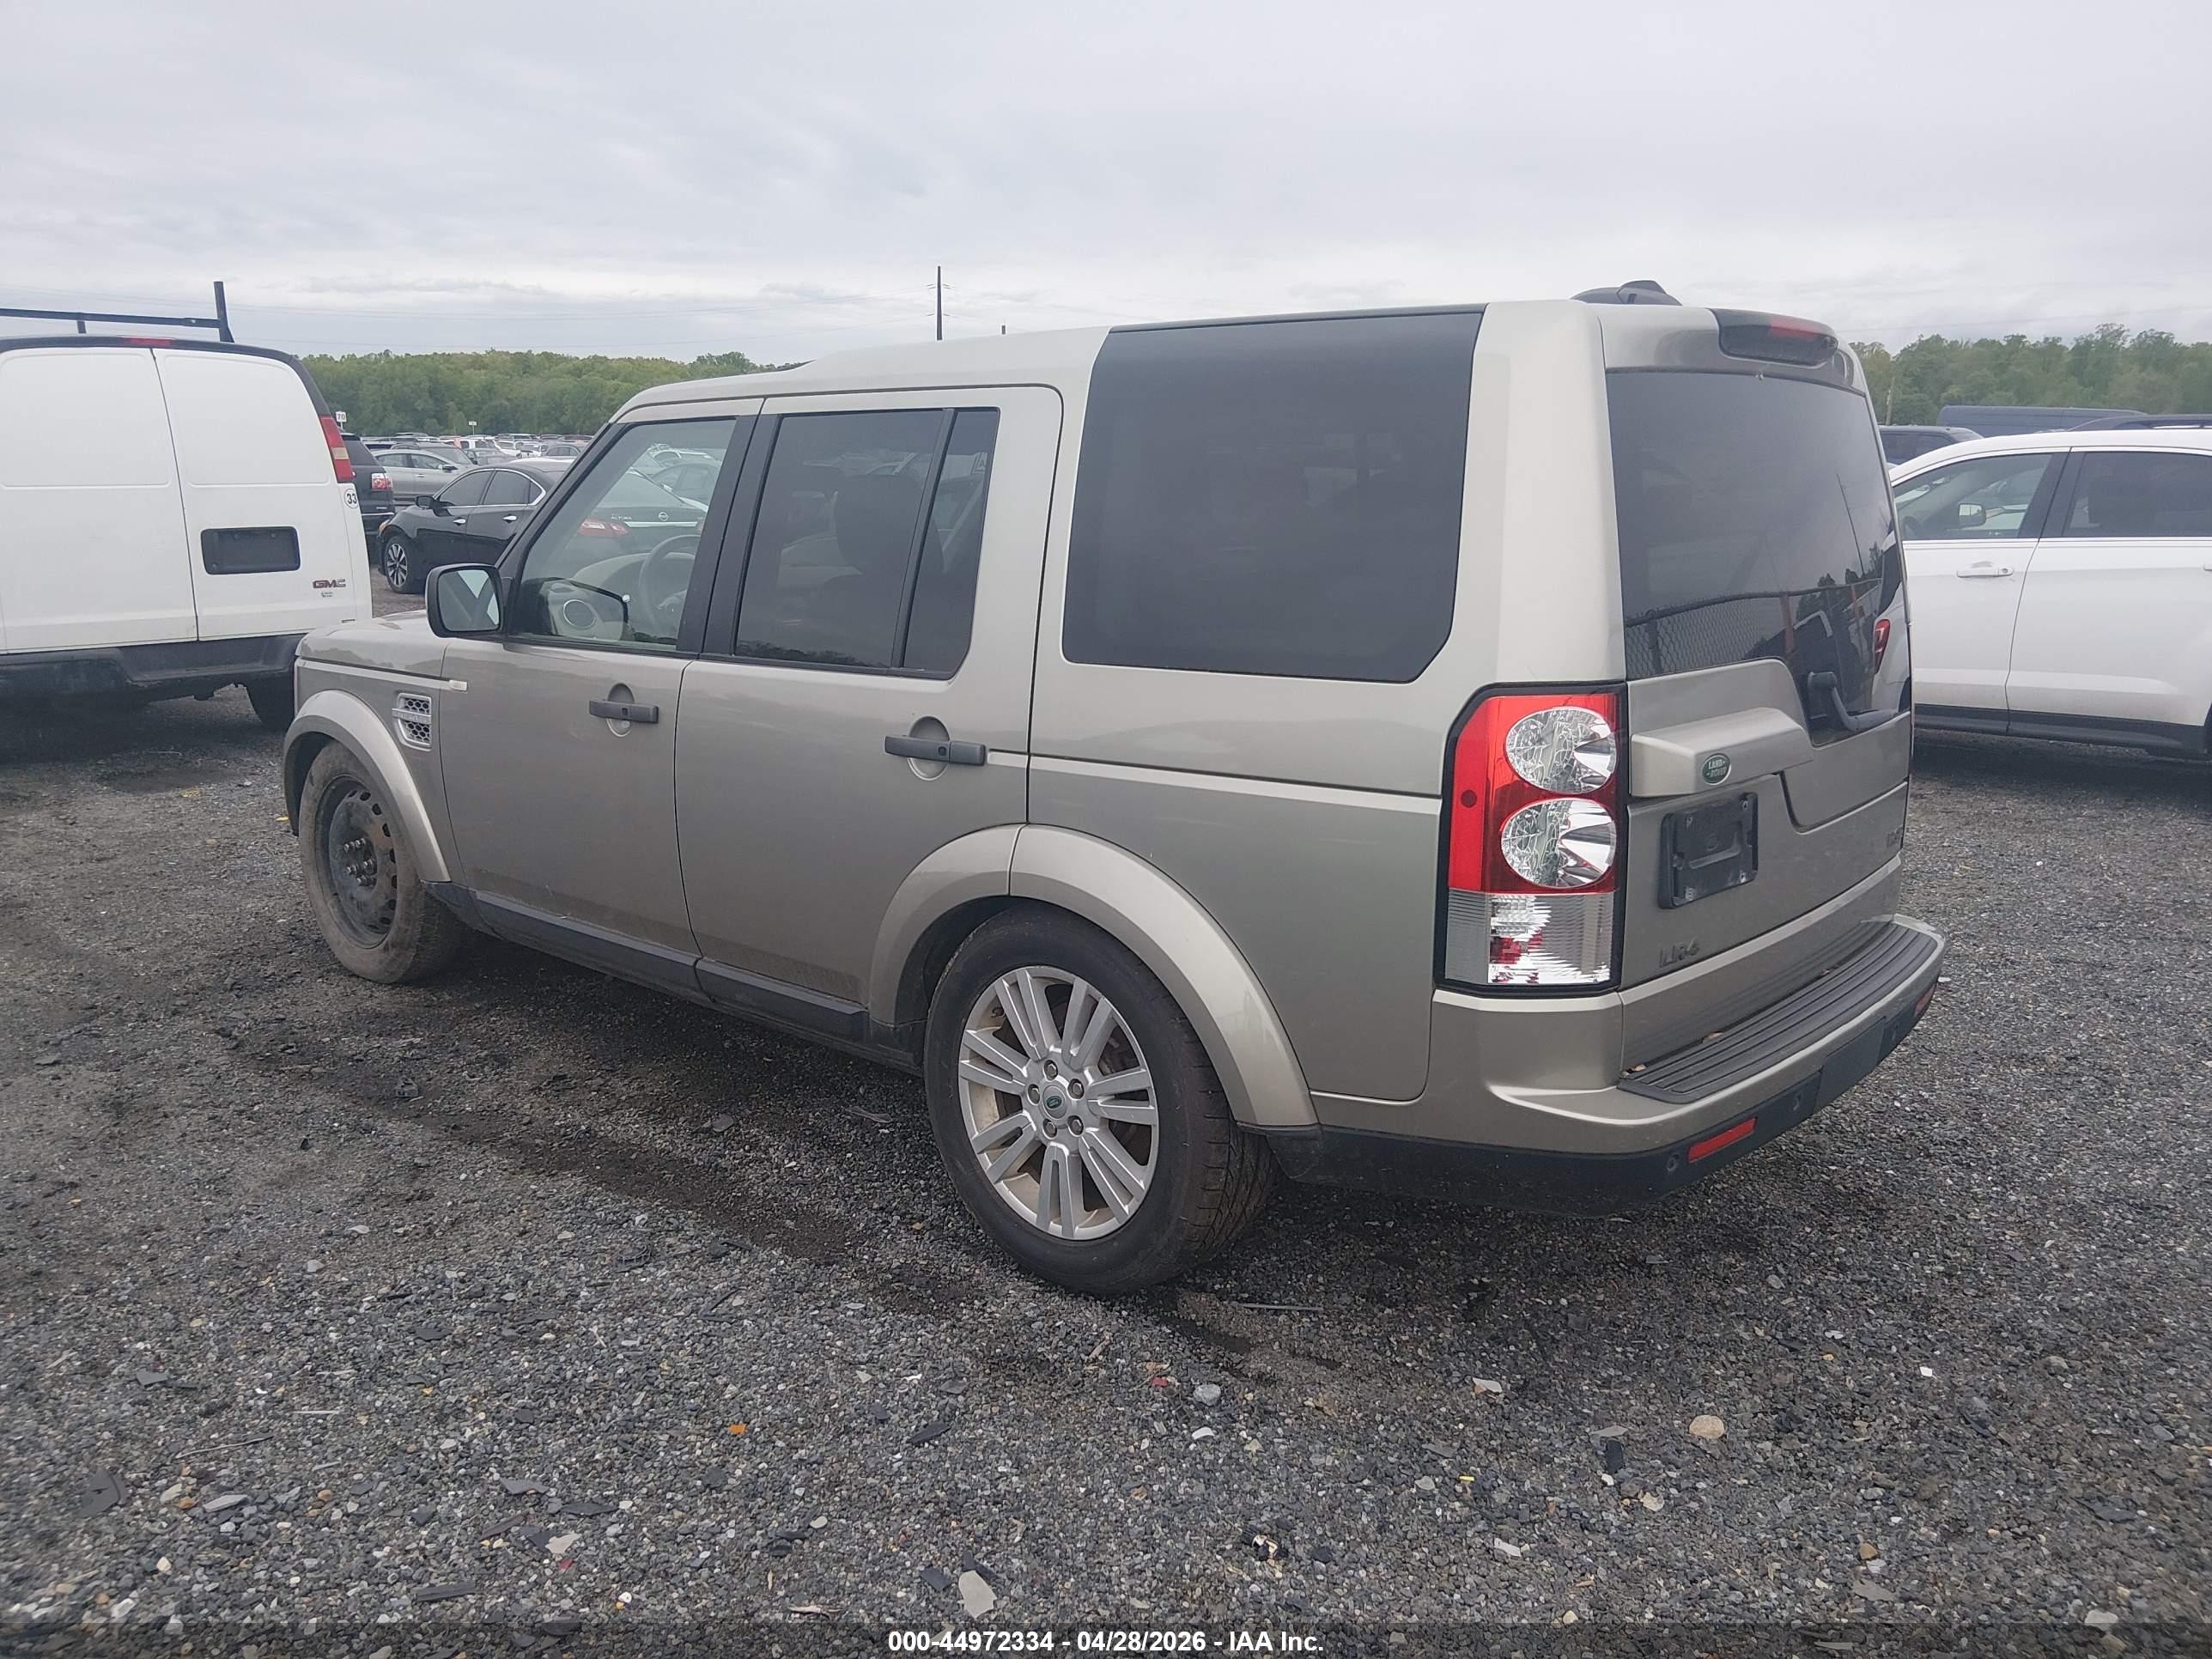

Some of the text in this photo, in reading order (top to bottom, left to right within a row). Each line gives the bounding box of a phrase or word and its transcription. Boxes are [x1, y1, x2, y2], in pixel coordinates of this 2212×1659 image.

[346, 493, 357, 505] 33
[313, 579, 346, 589] GMC
[1708, 759, 1723, 770] LAND
